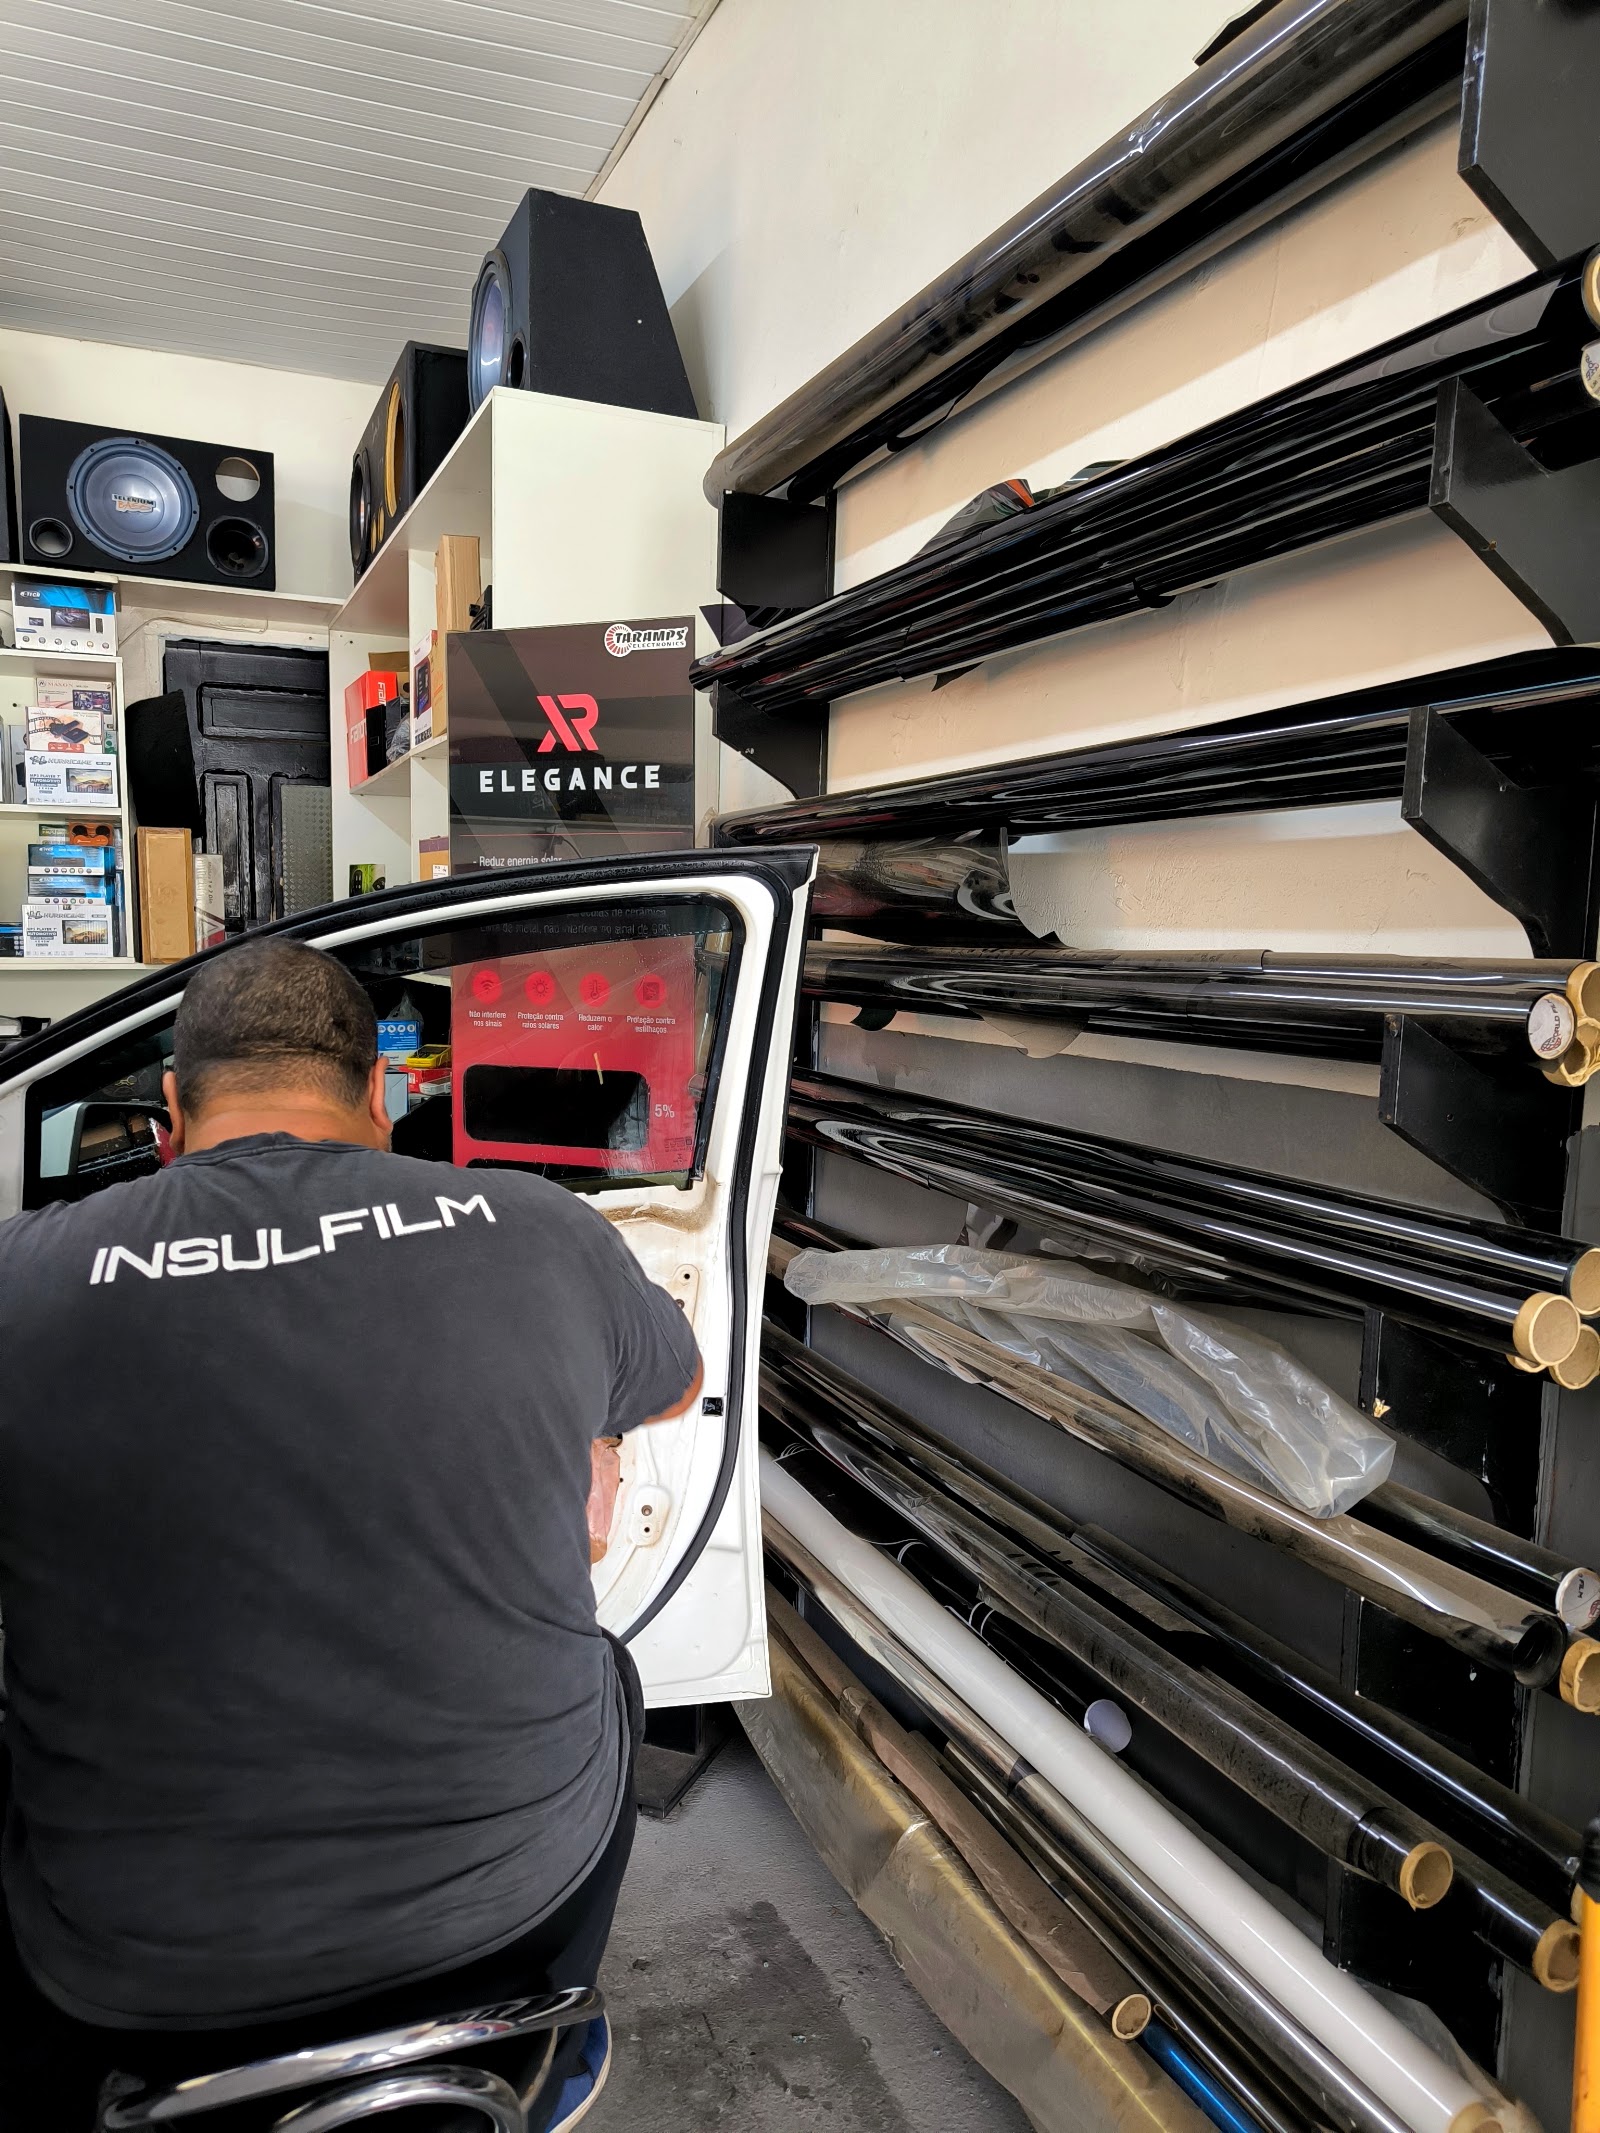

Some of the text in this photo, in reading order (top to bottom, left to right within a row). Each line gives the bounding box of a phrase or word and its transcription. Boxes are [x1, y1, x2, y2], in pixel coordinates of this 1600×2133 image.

[113, 494, 154, 505] SELENIUM
[615, 629, 685, 643] TARAMPS
[479, 765, 661, 793] ELEGANCE
[479, 855, 505, 867] Reduz
[468, 1009, 507, 1019] Não interfere
[517, 1011, 564, 1021] Proteção contra
[578, 1013, 607, 1022] Reduzem
[485, 1019, 503, 1027] sinais
[626, 1015, 676, 1025] Proteção contra
[538, 1021, 560, 1030] solares
[588, 1023, 604, 1031] calor
[635, 1025, 667, 1034] estilhaços
[654, 1103, 675, 1118] 5%
[89, 1193, 497, 1286] INSULFILM
